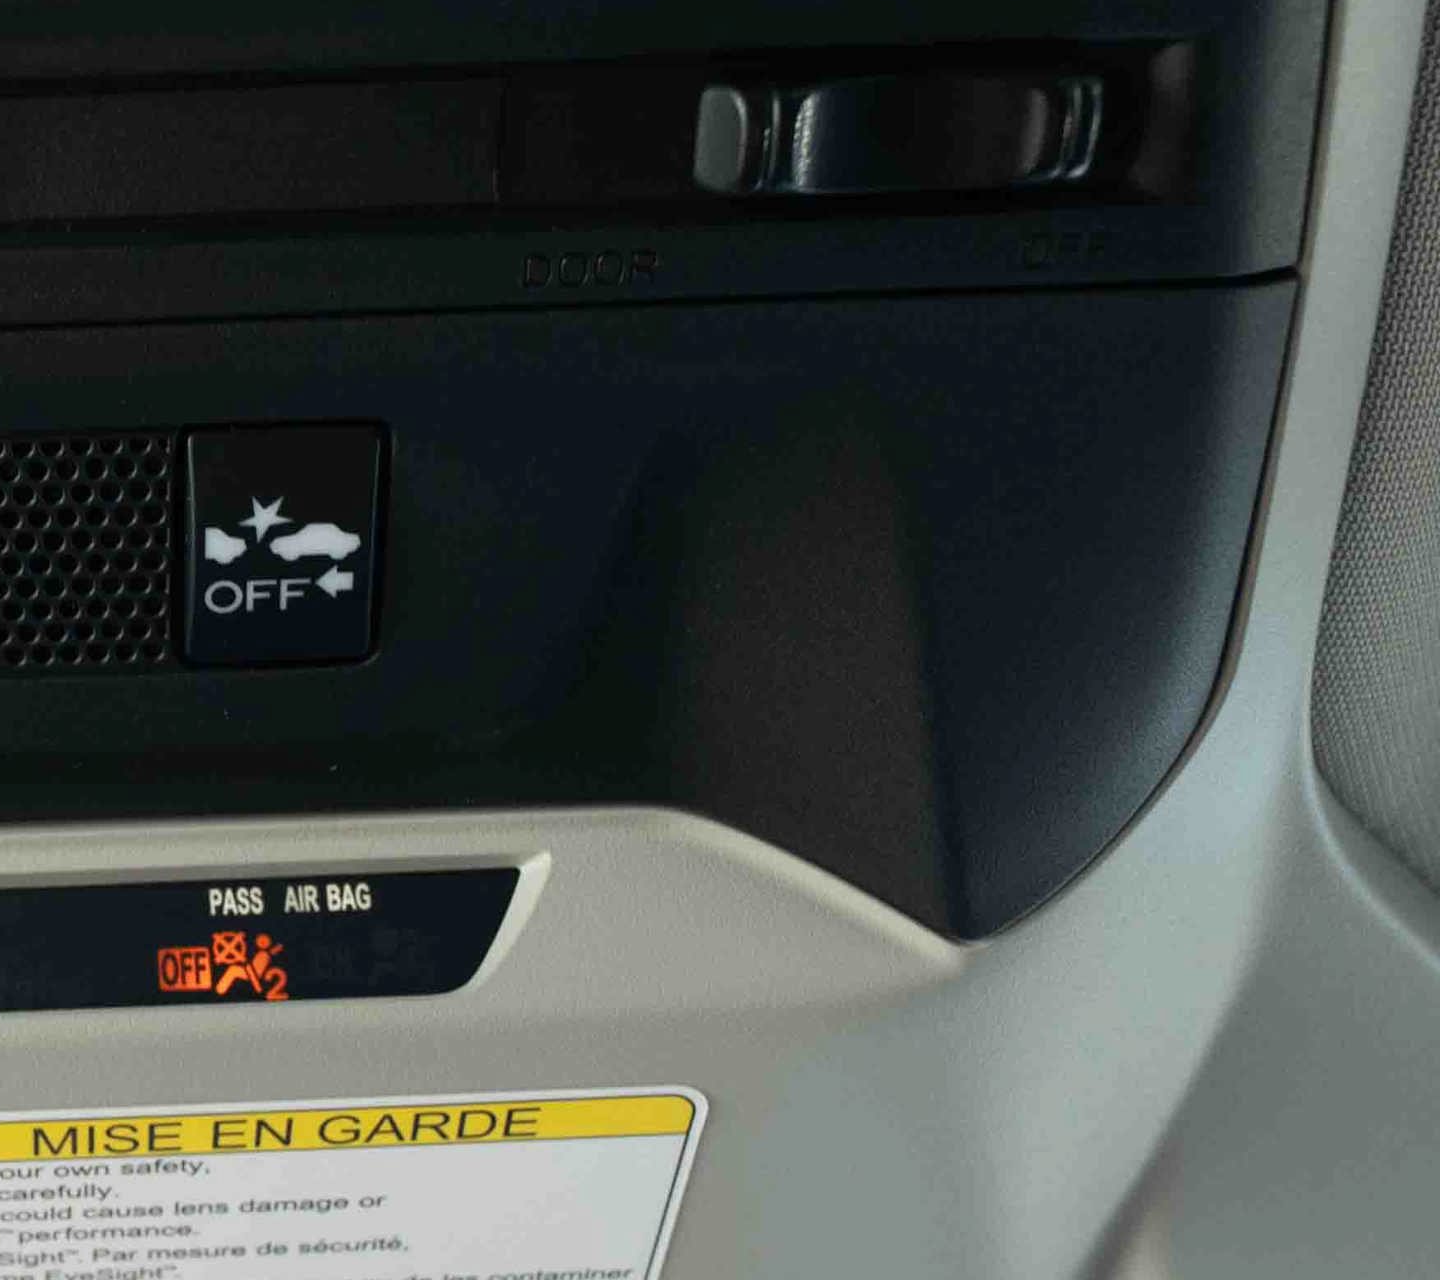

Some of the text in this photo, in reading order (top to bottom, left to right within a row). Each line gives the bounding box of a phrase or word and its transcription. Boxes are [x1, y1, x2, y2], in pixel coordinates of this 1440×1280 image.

[521, 249, 663, 289] DOOR
[203, 577, 314, 615] OFF
[207, 881, 373, 917] PASS AIR BAG
[161, 951, 207, 987] OFF
[32, 1106, 542, 1156] MISE EN GARDE
[53, 1163, 110, 1178] own
[120, 1157, 211, 1176] safety,
[0, 1206, 72, 1222] could
[83, 1205, 164, 1220] cause
[174, 1200, 229, 1215] lens
[239, 1195, 349, 1216] damage
[359, 1194, 387, 1208] or
[18, 1224, 200, 1245] performance.
[91, 1247, 137, 1262] Par
[147, 1244, 246, 1260] mesure
[256, 1240, 288, 1255] de
